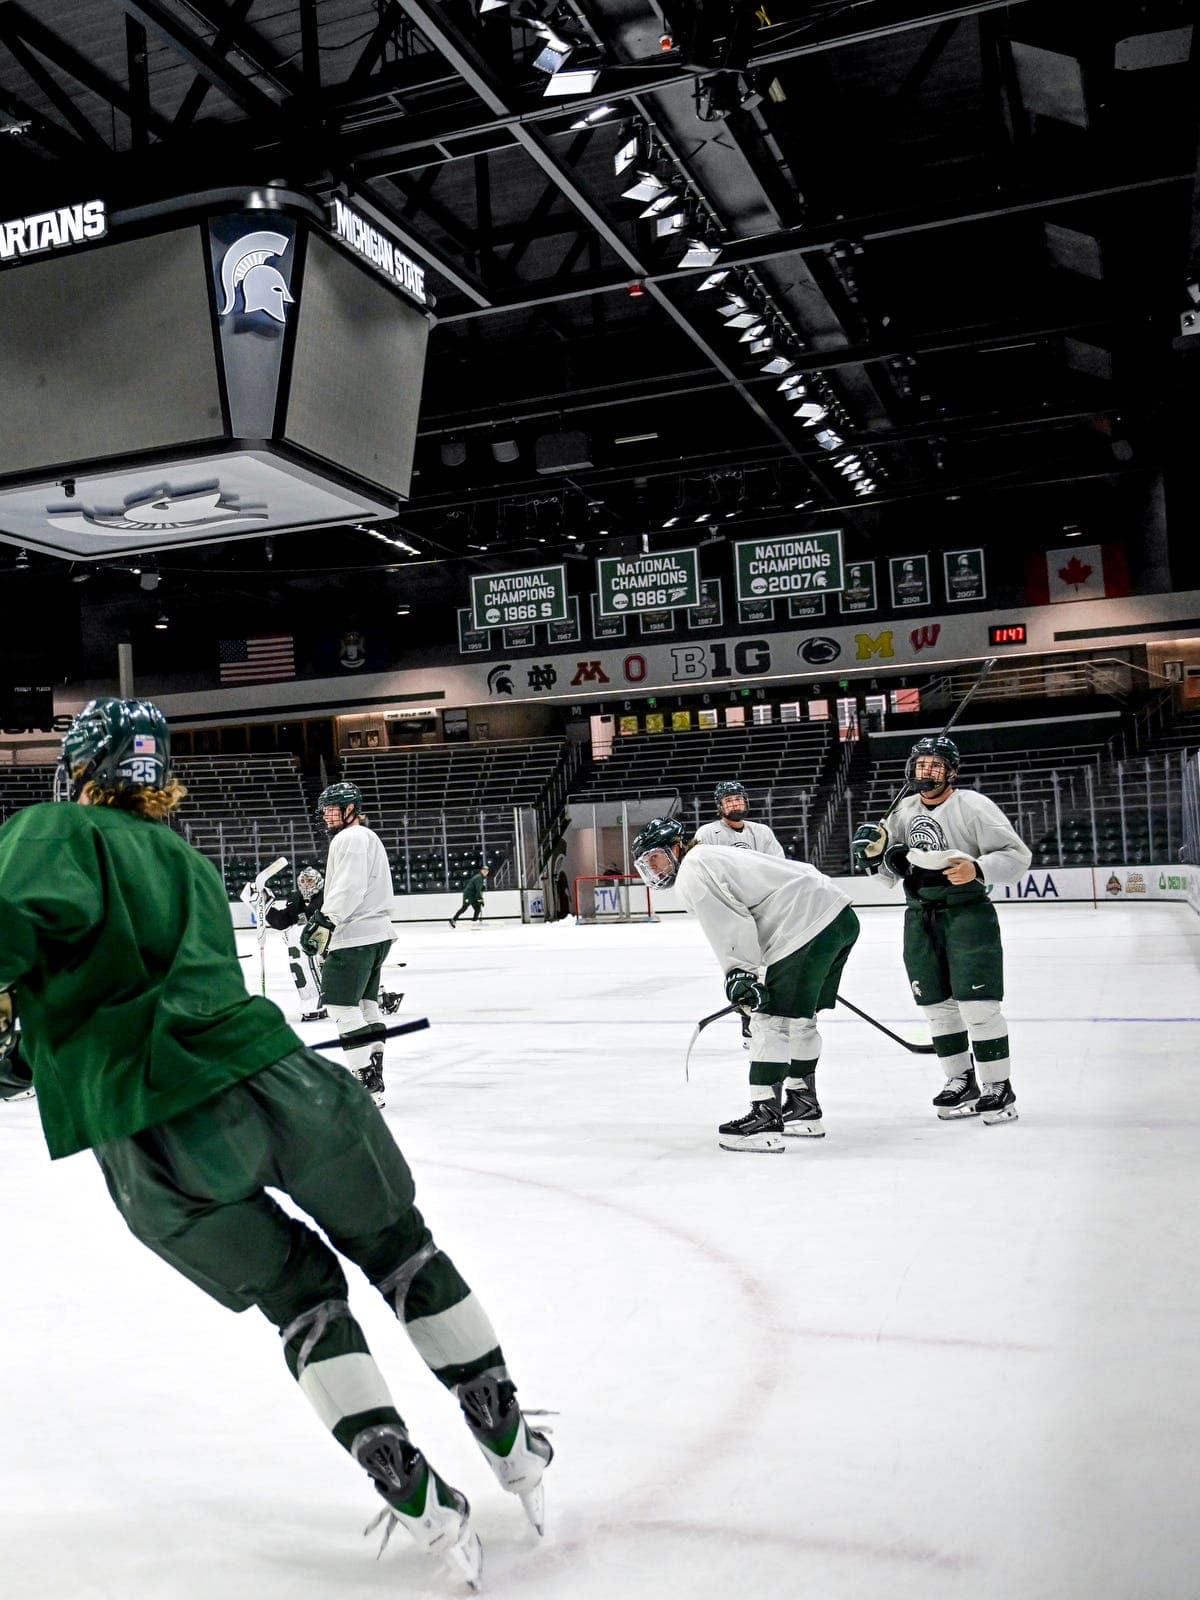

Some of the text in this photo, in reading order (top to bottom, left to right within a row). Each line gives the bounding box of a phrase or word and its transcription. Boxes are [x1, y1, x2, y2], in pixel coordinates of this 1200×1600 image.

[334, 197, 427, 304] MICHIGAN STATE
[755, 540, 824, 560] NATIONAL
[616, 557, 681, 576] NATIONAL
[749, 553, 832, 575] CHAMPIONS
[489, 574, 550, 593] NATIONAL
[611, 570, 688, 591] CHAMPIONS
[768, 573, 811, 592] 2007
[484, 586, 556, 606] CHAMPIONS
[631, 589, 667, 607] 1986
[956, 590, 976, 598] 2007
[503, 604, 537, 621] 1966
[854, 630, 894, 660] M
[132, 761, 156, 783] 25
